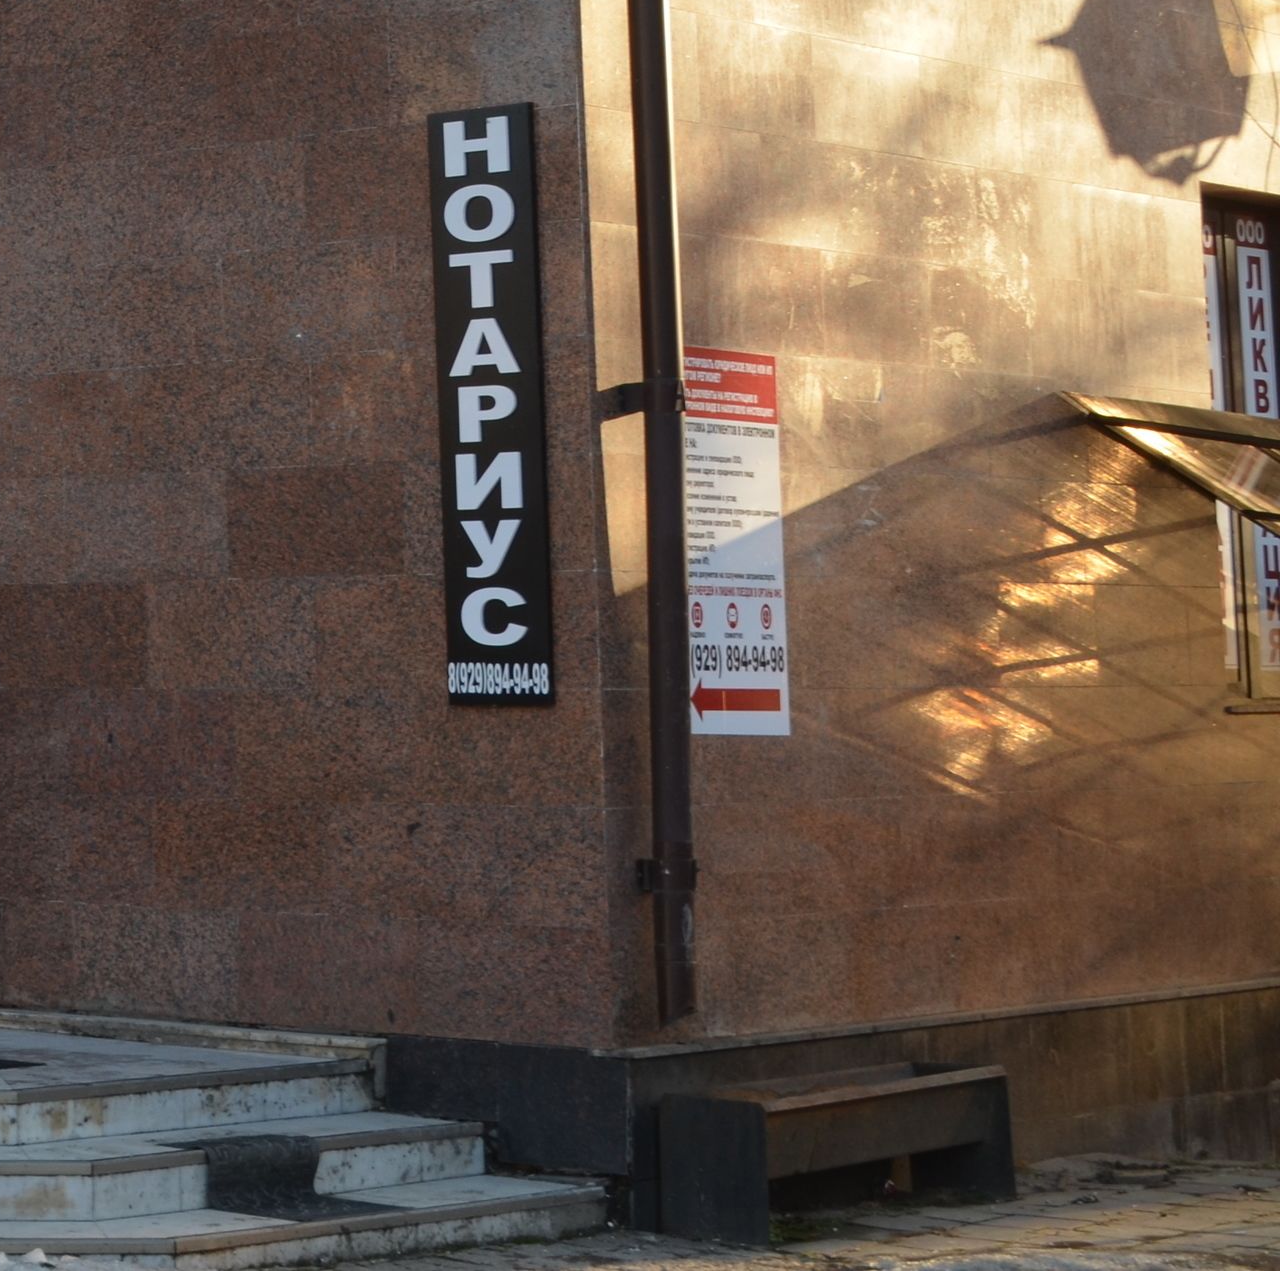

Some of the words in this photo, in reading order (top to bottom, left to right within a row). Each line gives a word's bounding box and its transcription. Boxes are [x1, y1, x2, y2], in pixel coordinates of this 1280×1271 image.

[443, 115, 529, 646] НОТАРИУС
[447, 662, 550, 695] 8(929)894-94-98
[691, 644, 721, 679] (929)
[726, 644, 784, 672] 894-94-98
